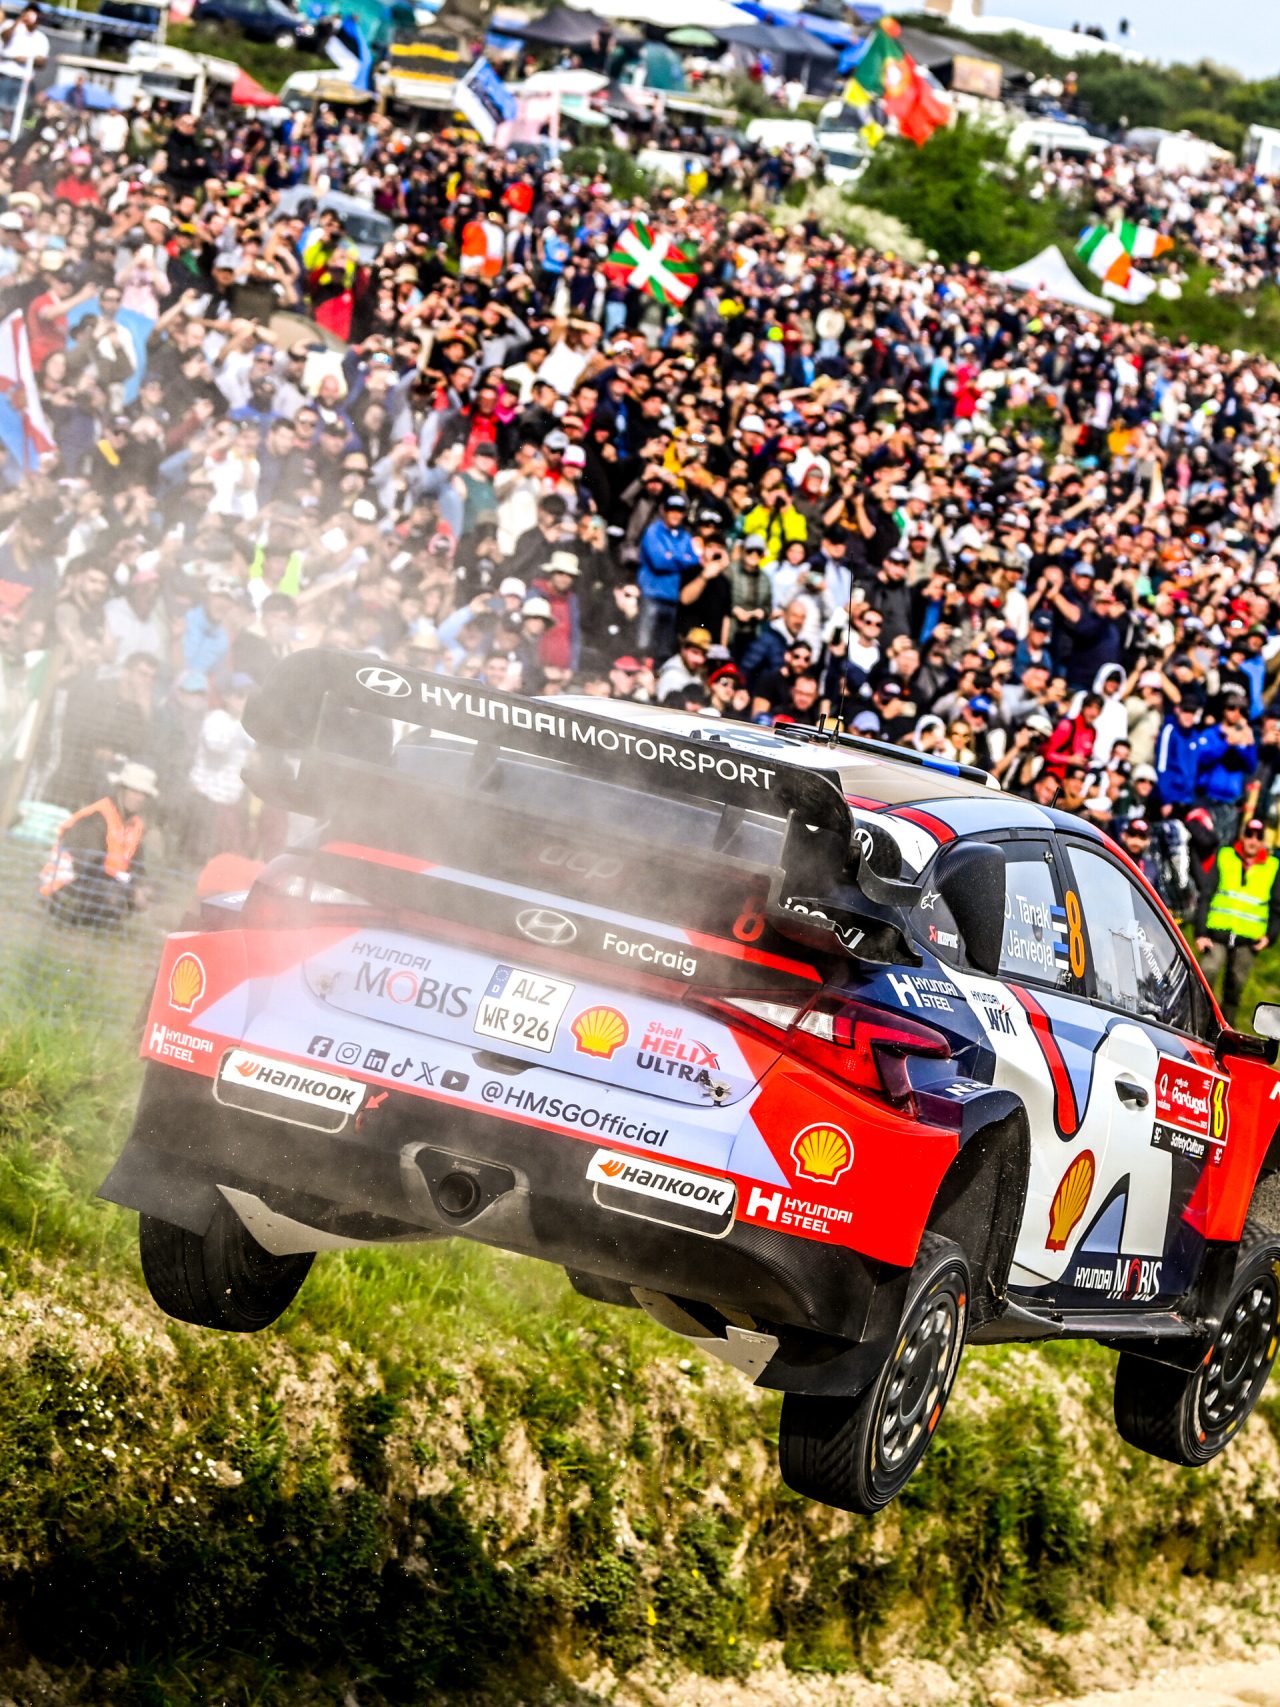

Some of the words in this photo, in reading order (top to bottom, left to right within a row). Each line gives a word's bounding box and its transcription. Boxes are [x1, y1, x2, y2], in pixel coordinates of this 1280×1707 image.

[421, 682, 566, 738] HYUNDAI
[571, 724, 777, 791] MOTORSPORT
[1065, 890, 1085, 979] 8
[352, 941, 432, 971] HYUNDAI
[602, 932, 698, 977] ForCraig
[1007, 929, 1054, 972] Järveoja
[354, 961, 473, 1018] MOBIS
[512, 978, 557, 1006] ALZ
[912, 976, 959, 997] HYUNDAI
[970, 990, 1000, 1005] HYUNDAI
[922, 994, 955, 1013] STEEL
[482, 1003, 510, 1031] WR
[512, 1013, 550, 1042] 926
[647, 1022, 684, 1040] Shell
[162, 1043, 195, 1064] STEEL
[166, 1029, 214, 1053] HYUNDAI
[640, 1034, 719, 1070] HELIX
[636, 1053, 710, 1086] ULTRA
[480, 1080, 670, 1148] @HMSGOfficial
[1172, 1086, 1209, 1115] Portugal
[1213, 1080, 1225, 1138] 8
[780, 1211, 831, 1235] STEEL
[784, 1197, 853, 1224] HYUNDAI
[1073, 1266, 1114, 1291] HYUNDAI
[1106, 1257, 1163, 1302] MOBIS
